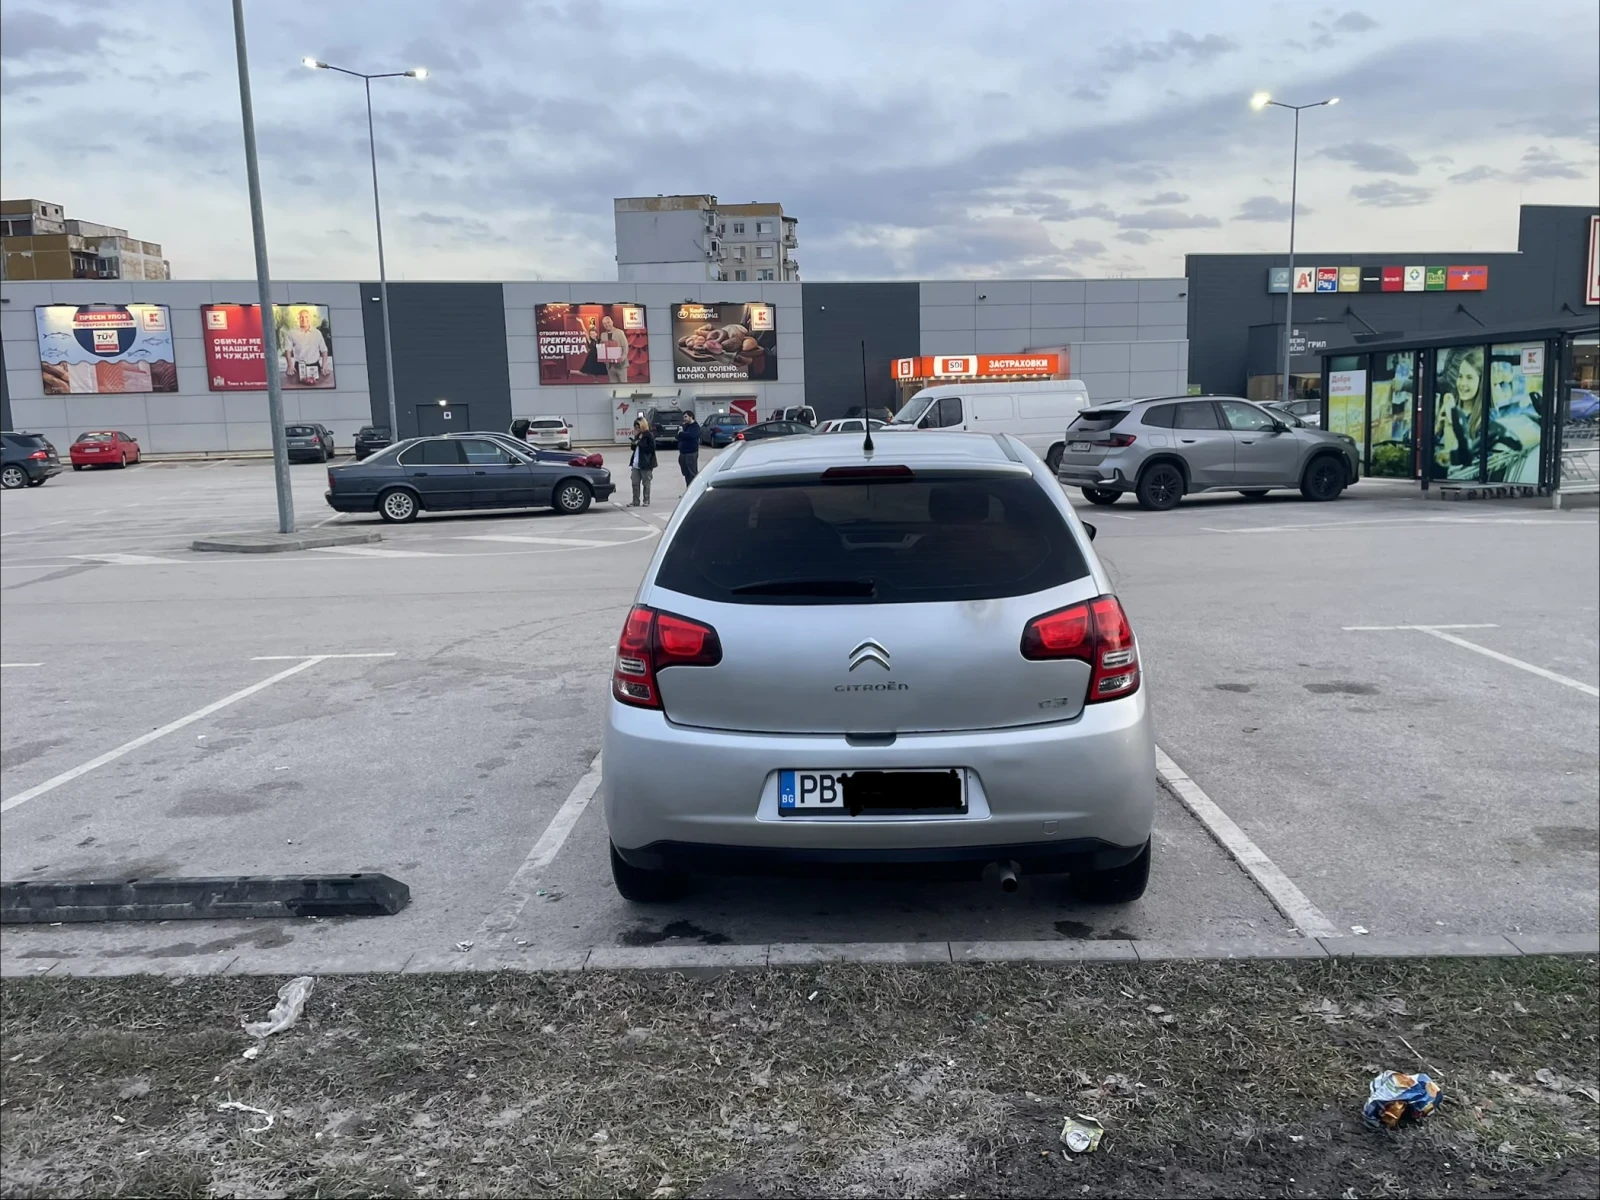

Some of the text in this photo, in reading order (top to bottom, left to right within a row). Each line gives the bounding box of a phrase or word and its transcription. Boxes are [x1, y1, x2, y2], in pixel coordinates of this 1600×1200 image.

[1297, 270, 1312, 288] A1
[1319, 272, 1336, 281] Easy
[1319, 281, 1332, 289] Pay
[541, 345, 588, 355] КОЛЕДА
[950, 361, 962, 369] SDI
[989, 359, 1048, 369] ЗАСТРАХОВКИ
[800, 774, 838, 804] PB
[782, 794, 794, 803] BG
